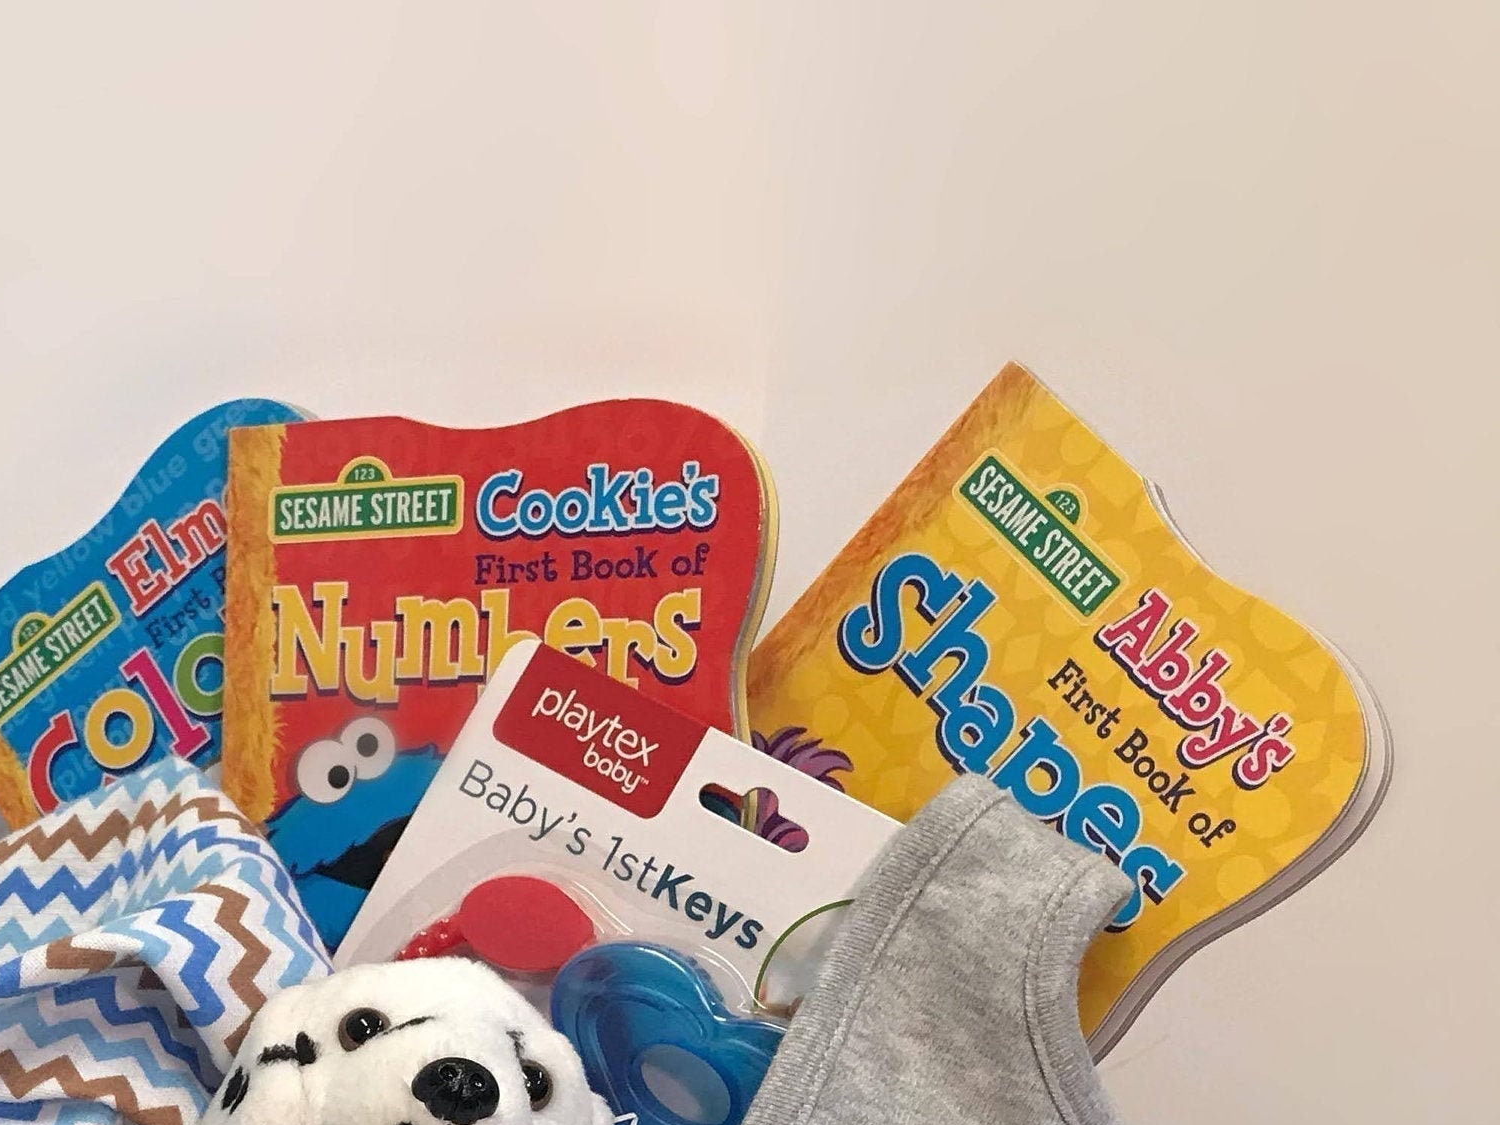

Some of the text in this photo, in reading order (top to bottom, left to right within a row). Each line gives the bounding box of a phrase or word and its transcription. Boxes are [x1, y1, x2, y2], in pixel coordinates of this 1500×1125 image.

[280, 488, 453, 531] SESAME STREET
[354, 468, 376, 481] 123
[476, 460, 719, 538] Cookie's
[1055, 494, 1077, 516] 123
[105, 486, 228, 617] Elm
[474, 542, 711, 585] First Book of
[969, 465, 1113, 607] SESAME STREET
[20, 622, 39, 641] 123
[45, 594, 109, 662] STREET
[145, 588, 211, 649] First
[28, 630, 227, 817] Colo
[531, 687, 660, 767] playtex
[1094, 588, 1296, 788] Abby's
[839, 553, 1186, 931] Shapes
[1047, 658, 1237, 848] First Book of
[458, 759, 592, 856] Baby's
